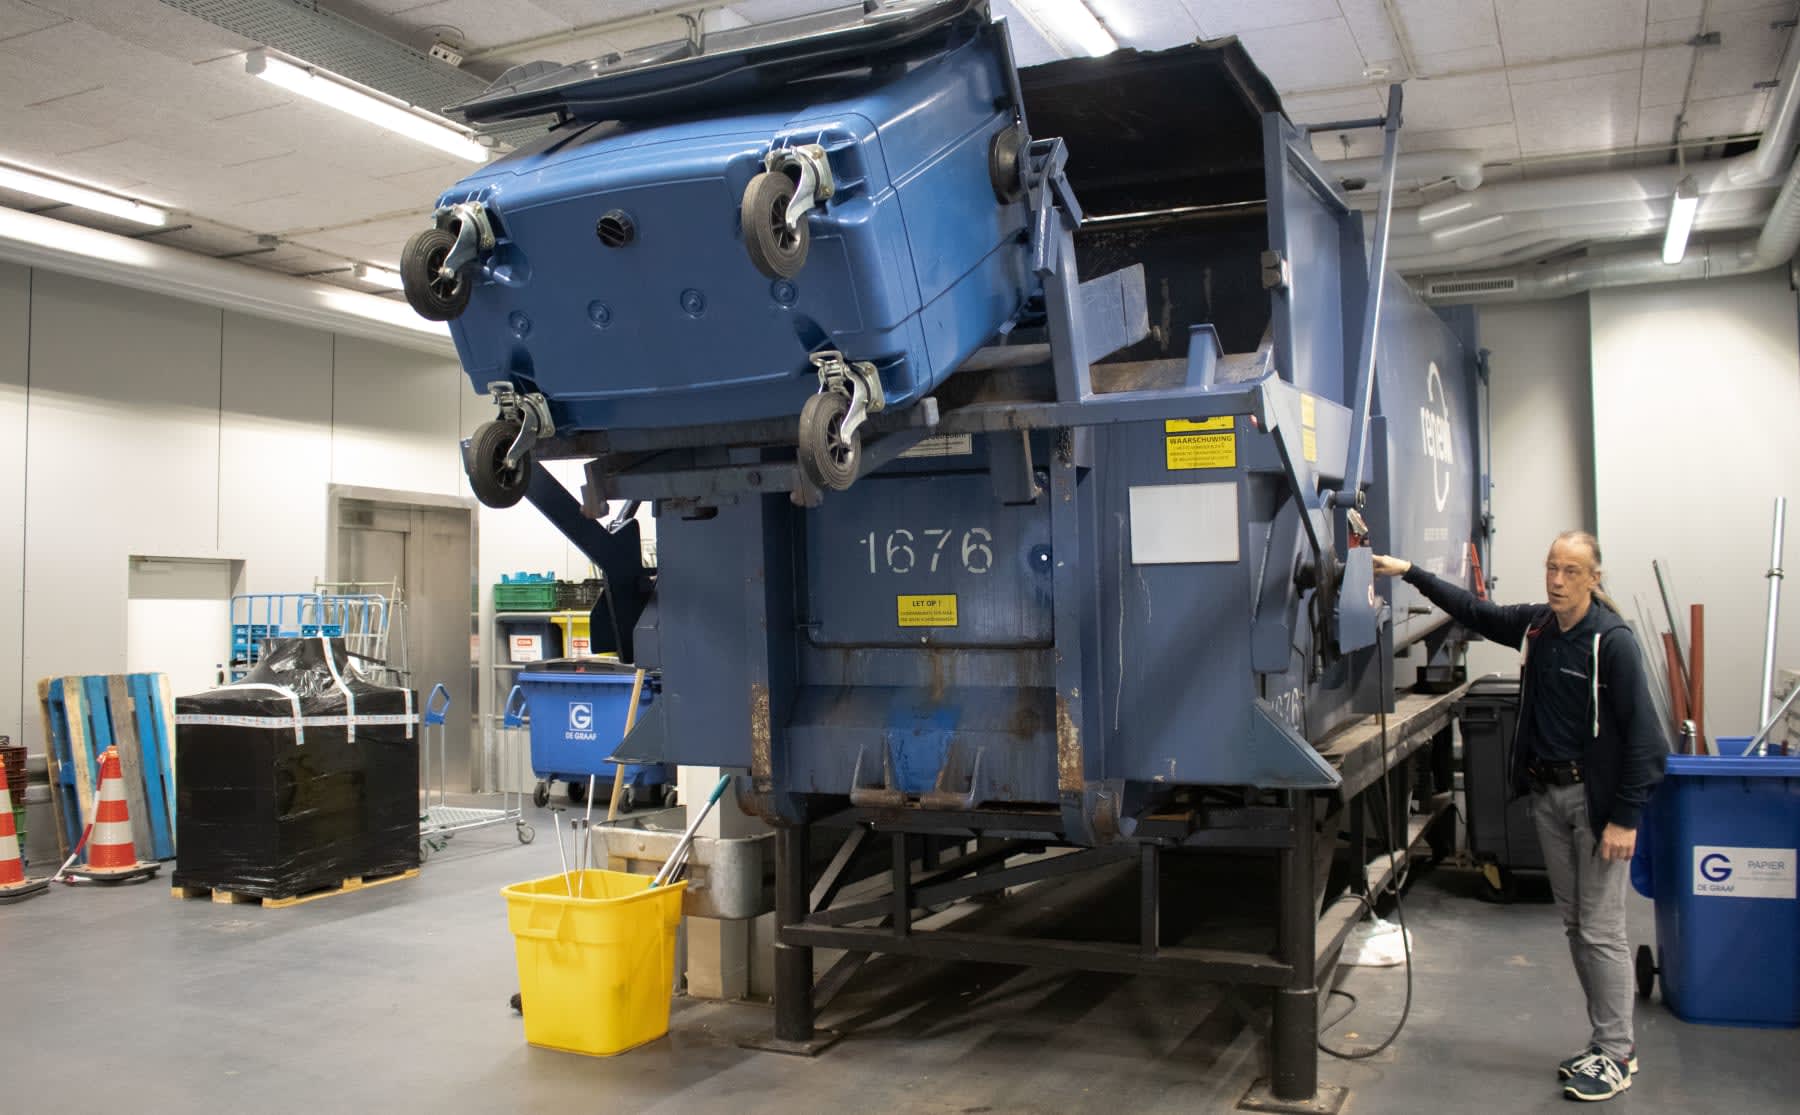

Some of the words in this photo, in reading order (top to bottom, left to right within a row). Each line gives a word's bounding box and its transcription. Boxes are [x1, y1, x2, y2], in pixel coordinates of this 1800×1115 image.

[1170, 435, 1232, 445] WAARSCHUWING
[859, 527, 993, 574] 1676
[571, 704, 591, 729] G
[1700, 854, 1732, 881] G
[1747, 860, 1785, 870] PAPIER
[1697, 883, 1708, 891] DE
